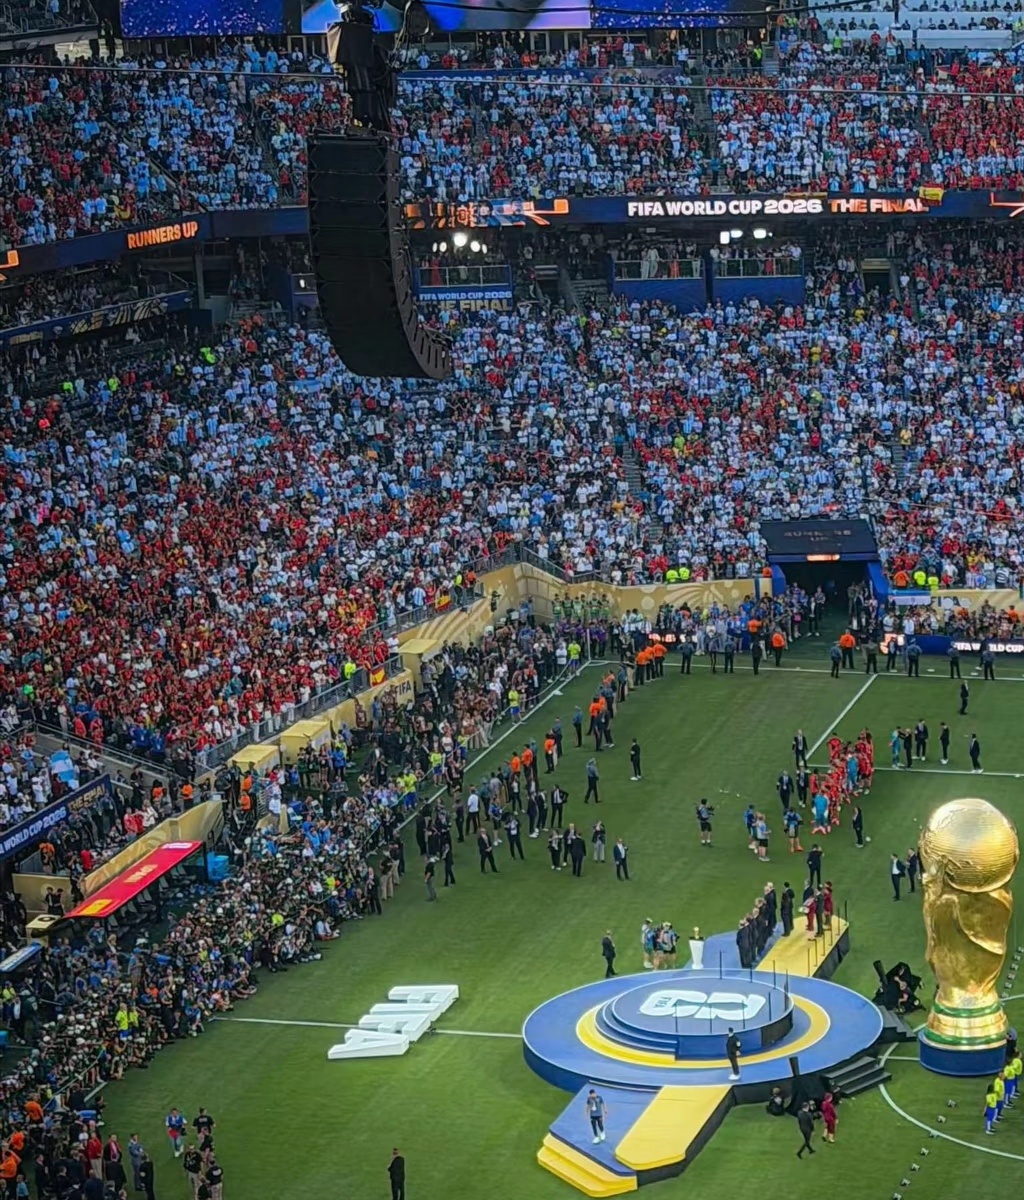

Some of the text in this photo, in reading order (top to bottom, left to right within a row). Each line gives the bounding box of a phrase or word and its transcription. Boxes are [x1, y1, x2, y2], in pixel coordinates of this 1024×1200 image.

[628, 201, 664, 216] FIFA
[664, 201, 725, 215] WORLD
[729, 200, 762, 215] CUP
[764, 199, 822, 214] 2026
[828, 199, 867, 213] THE
[127, 221, 199, 249] RUNNERS UP
[420, 293, 437, 301] FIFA
[467, 292, 483, 300] CUP
[484, 291, 513, 299] 2026
[1006, 644, 1024, 653] CUP
[4, 830, 29, 852] WORLD
[29, 820, 43, 836] CUP
[43, 806, 67, 828] 2026
